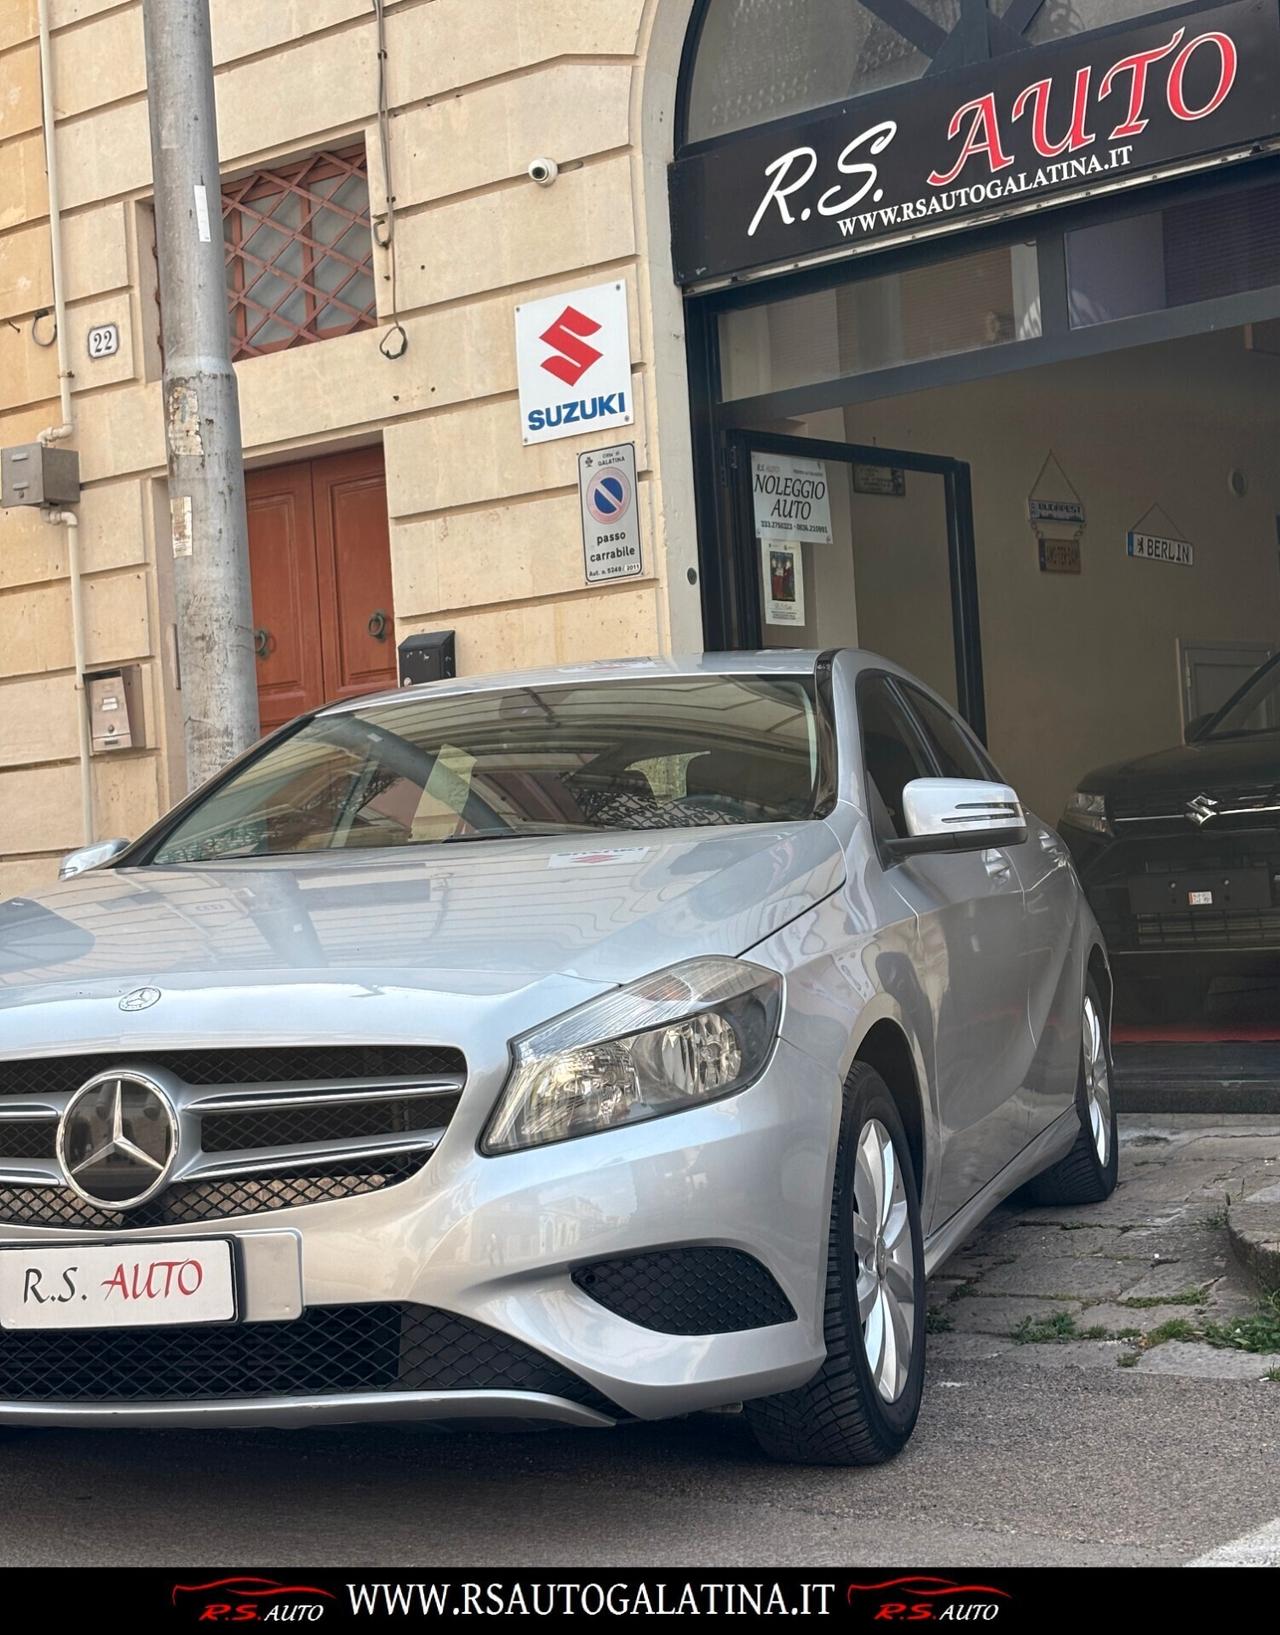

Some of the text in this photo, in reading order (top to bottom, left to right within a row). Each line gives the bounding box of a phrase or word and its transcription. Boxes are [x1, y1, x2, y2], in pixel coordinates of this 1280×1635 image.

[747, 26, 1238, 236] R.S. AUTO
[836, 145, 1134, 238] WWW.RSAUTOGALATINA.IT
[93, 330, 112, 353] 22
[528, 392, 626, 431] SUZUKI
[598, 456, 625, 466] GALATINA
[754, 474, 826, 500] NOLEGGIO
[770, 499, 812, 520] AUTO
[597, 532, 626, 546] passo
[1146, 538, 1190, 563] BERLIN
[590, 545, 635, 562] carrabile
[23, 1258, 203, 1304] R.S. AUTO
